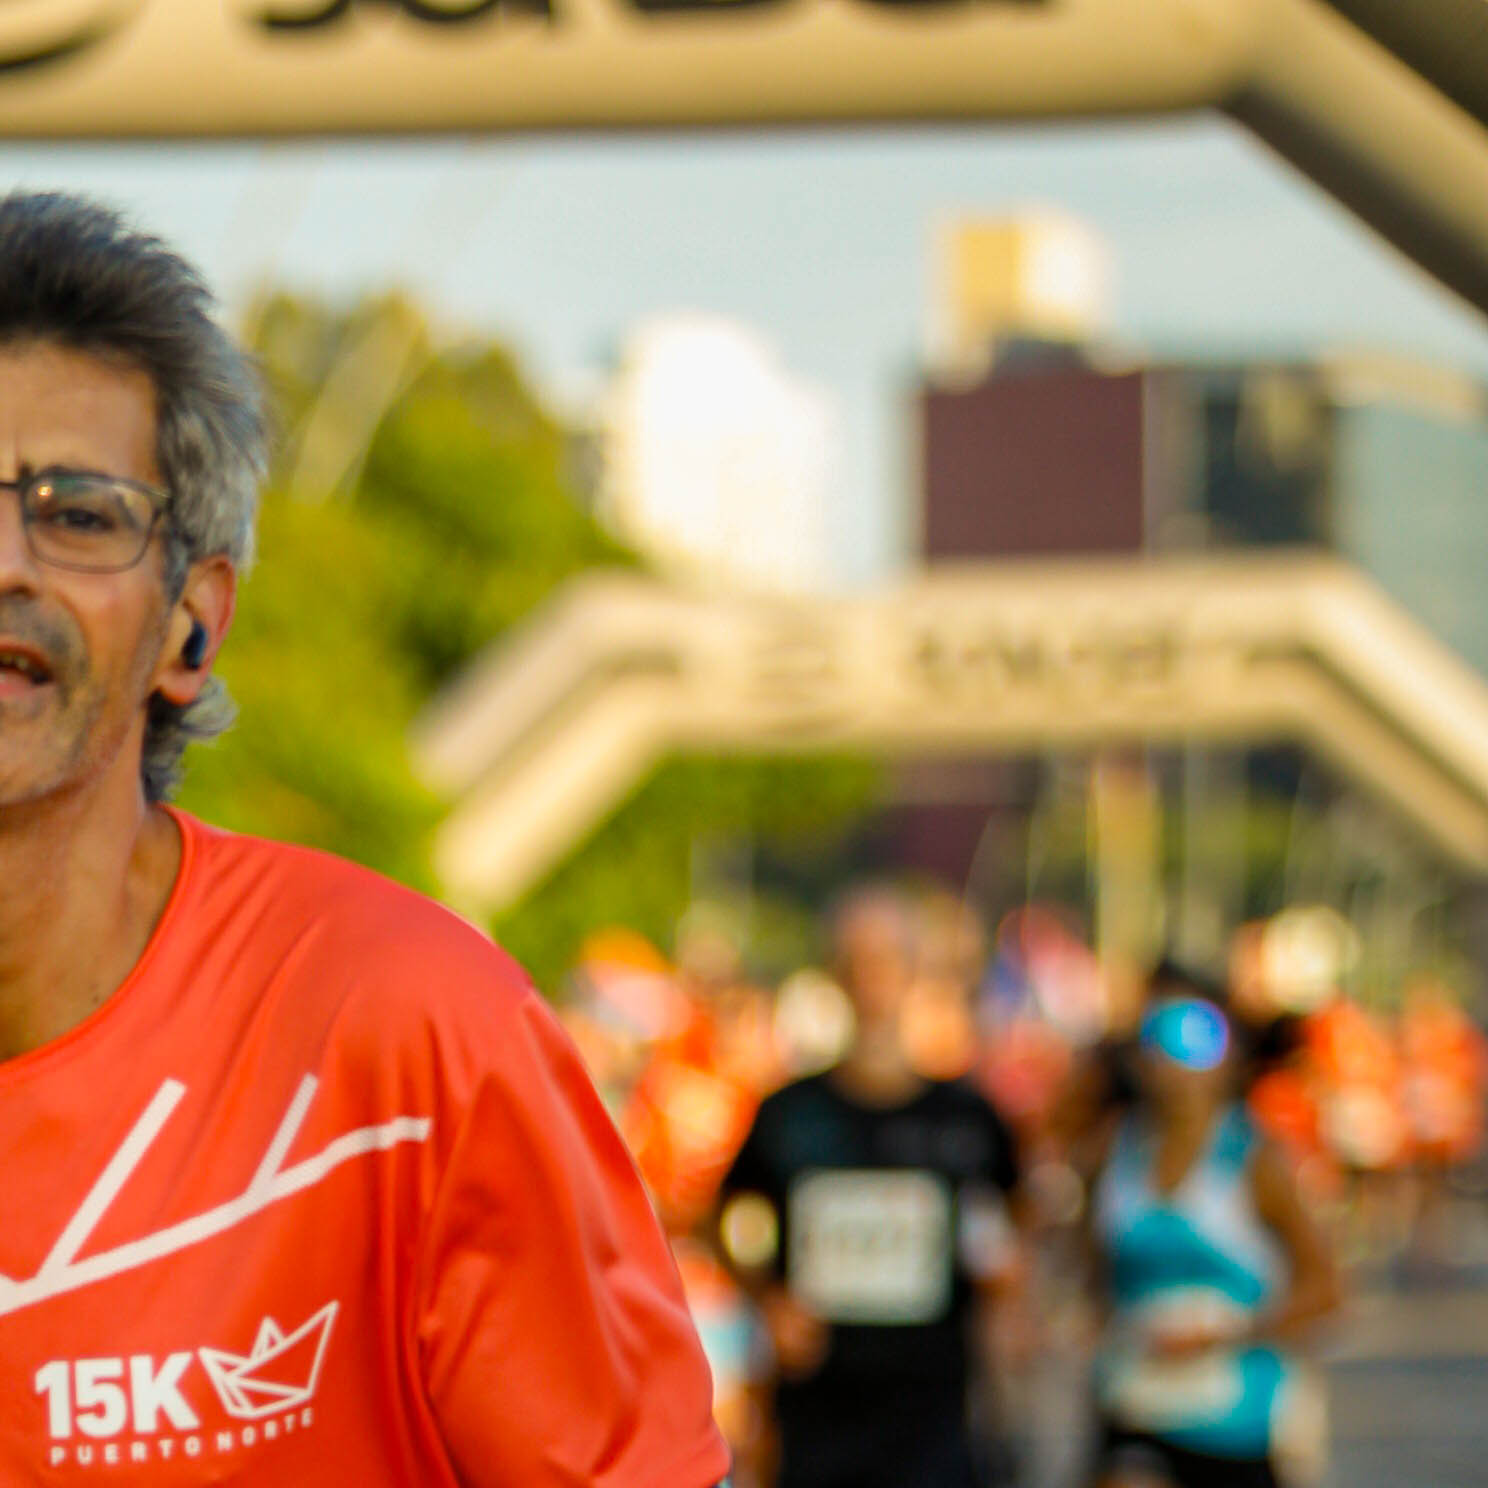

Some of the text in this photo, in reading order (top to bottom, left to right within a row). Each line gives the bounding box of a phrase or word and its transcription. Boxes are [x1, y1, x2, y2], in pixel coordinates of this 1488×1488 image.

[34, 1350, 201, 1440] 15K
[49, 1406, 314, 1467] PUERTO NORTE
